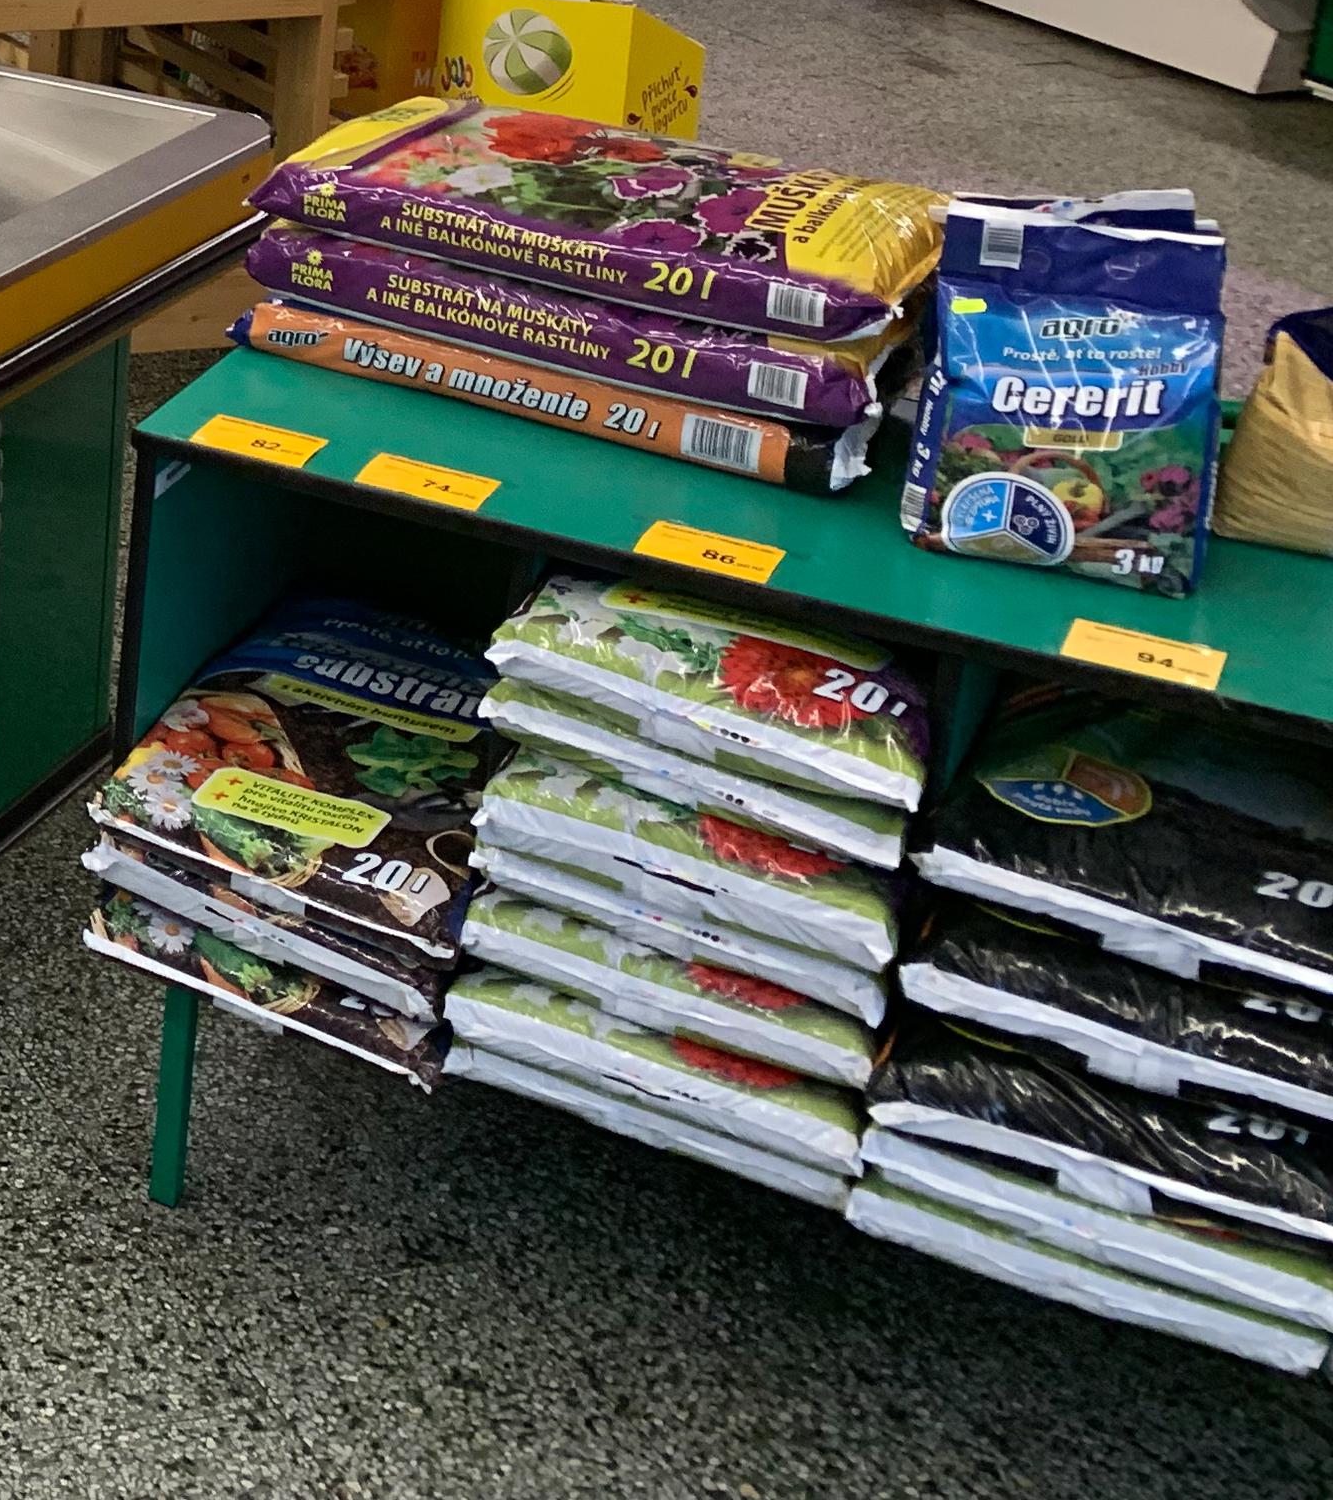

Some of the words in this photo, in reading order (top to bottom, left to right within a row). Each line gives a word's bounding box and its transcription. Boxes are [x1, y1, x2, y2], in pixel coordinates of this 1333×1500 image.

[303, 194, 347, 212] PRIMA
[303, 205, 346, 223] FLORA
[380, 215, 392, 230] A
[395, 216, 424, 238] INÉ
[427, 225, 534, 264] BALKÓNOVÉ
[538, 251, 628, 285] RASTLINY
[401, 201, 486, 235] SUBSTRÁT
[490, 221, 519, 244] NA
[520, 229, 611, 263] MUŠKÁTY
[291, 262, 334, 281] PRIMA
[291, 273, 333, 292] FLORA
[643, 261, 695, 297] 20
[387, 274, 474, 308] SUBSTRÁT
[477, 294, 503, 316] NA
[505, 302, 593, 337] MUŠKÁTY
[266, 327, 323, 347] agro
[366, 288, 379, 302] A
[382, 290, 410, 311] INÉ
[413, 296, 520, 339] BALKÓNOVÉ
[522, 327, 611, 361] RASTLINY
[1039, 316, 1122, 341] agro
[626, 338, 676, 375] 20
[342, 337, 424, 379] Výsev
[424, 363, 445, 385] a
[448, 366, 590, 422] množenie
[602, 403, 648, 434] 20
[992, 375, 1165, 418] Cererit
[700, 546, 736, 566] 86
[1111, 549, 1135, 576] 3
[1137, 651, 1174, 669] 94
[812, 668, 889, 715] 20
[243, 787, 267, 802] pro
[252, 780, 310, 804] VITALITY
[311, 796, 377, 822] KOMPLEX
[238, 795, 288, 816] hnojivo
[288, 807, 366, 834] KRISTALON
[342, 852, 409, 895] 20
